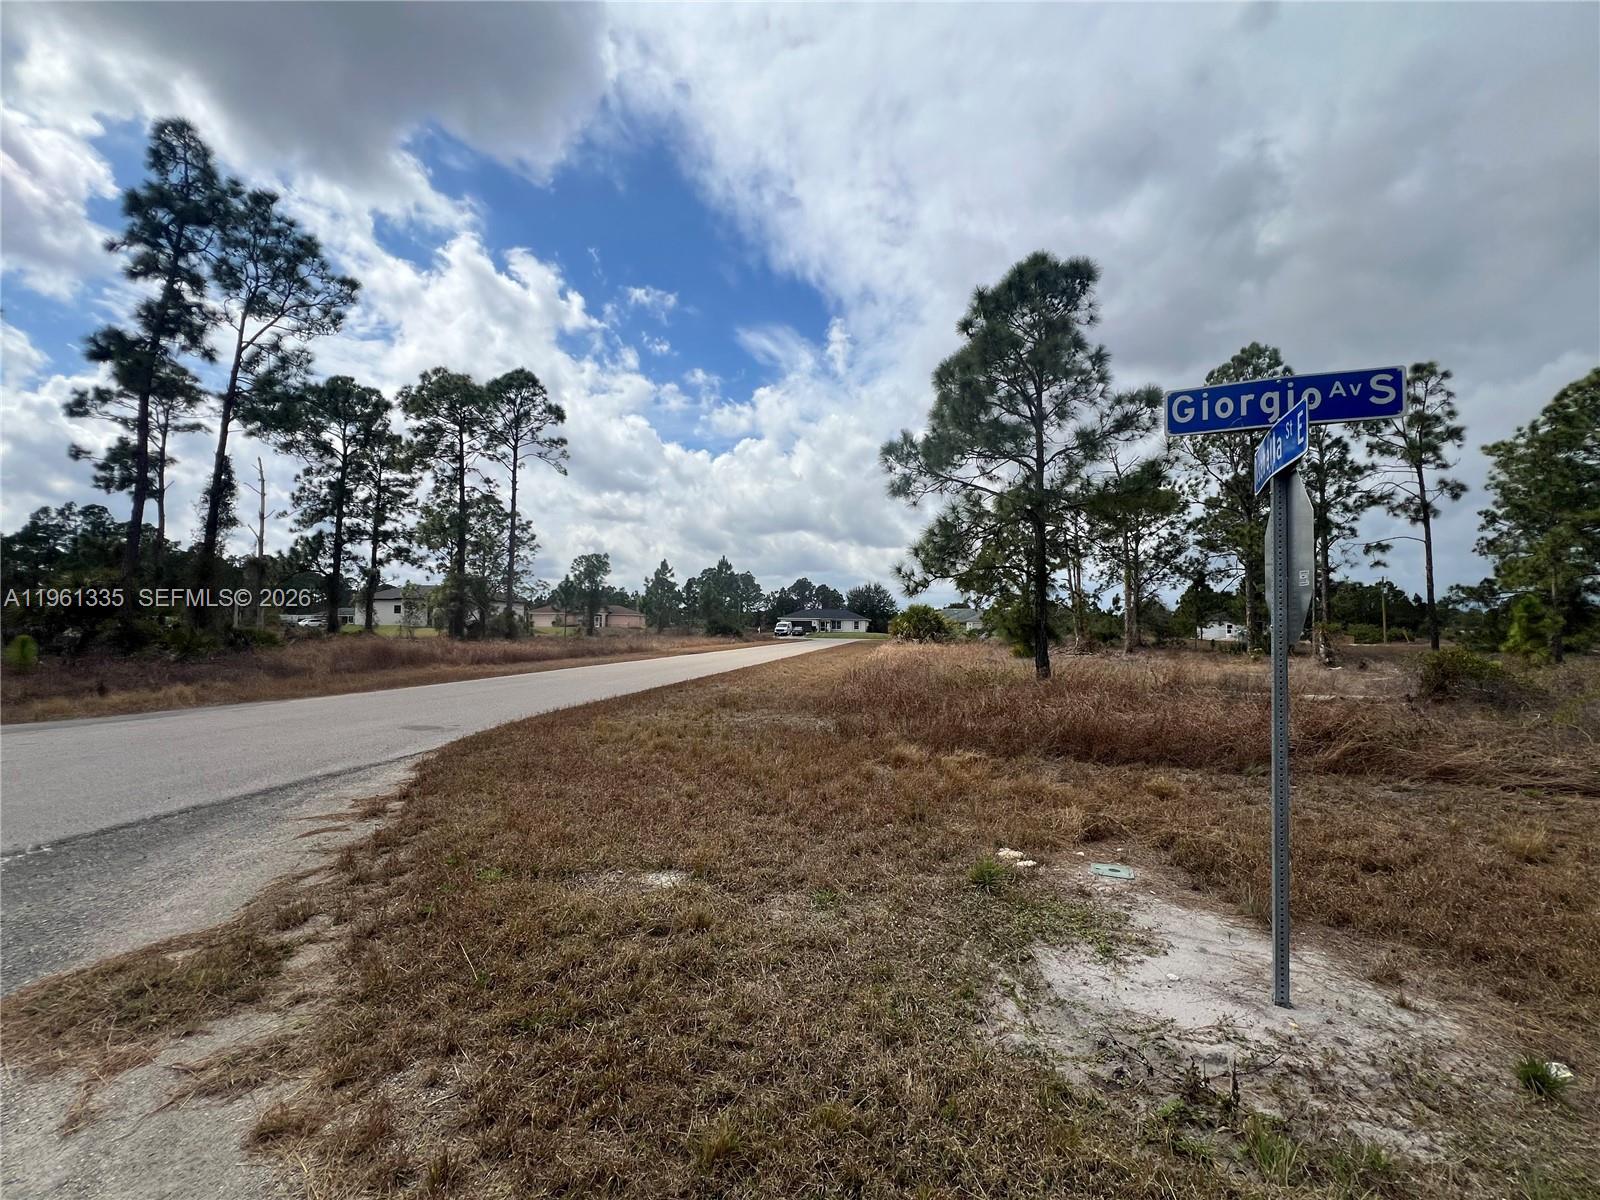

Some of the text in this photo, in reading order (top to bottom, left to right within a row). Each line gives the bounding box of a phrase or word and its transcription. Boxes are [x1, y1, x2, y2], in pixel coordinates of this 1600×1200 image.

[1171, 373, 1397, 423] Giorgio Av S
[1297, 410, 1304, 446] E
